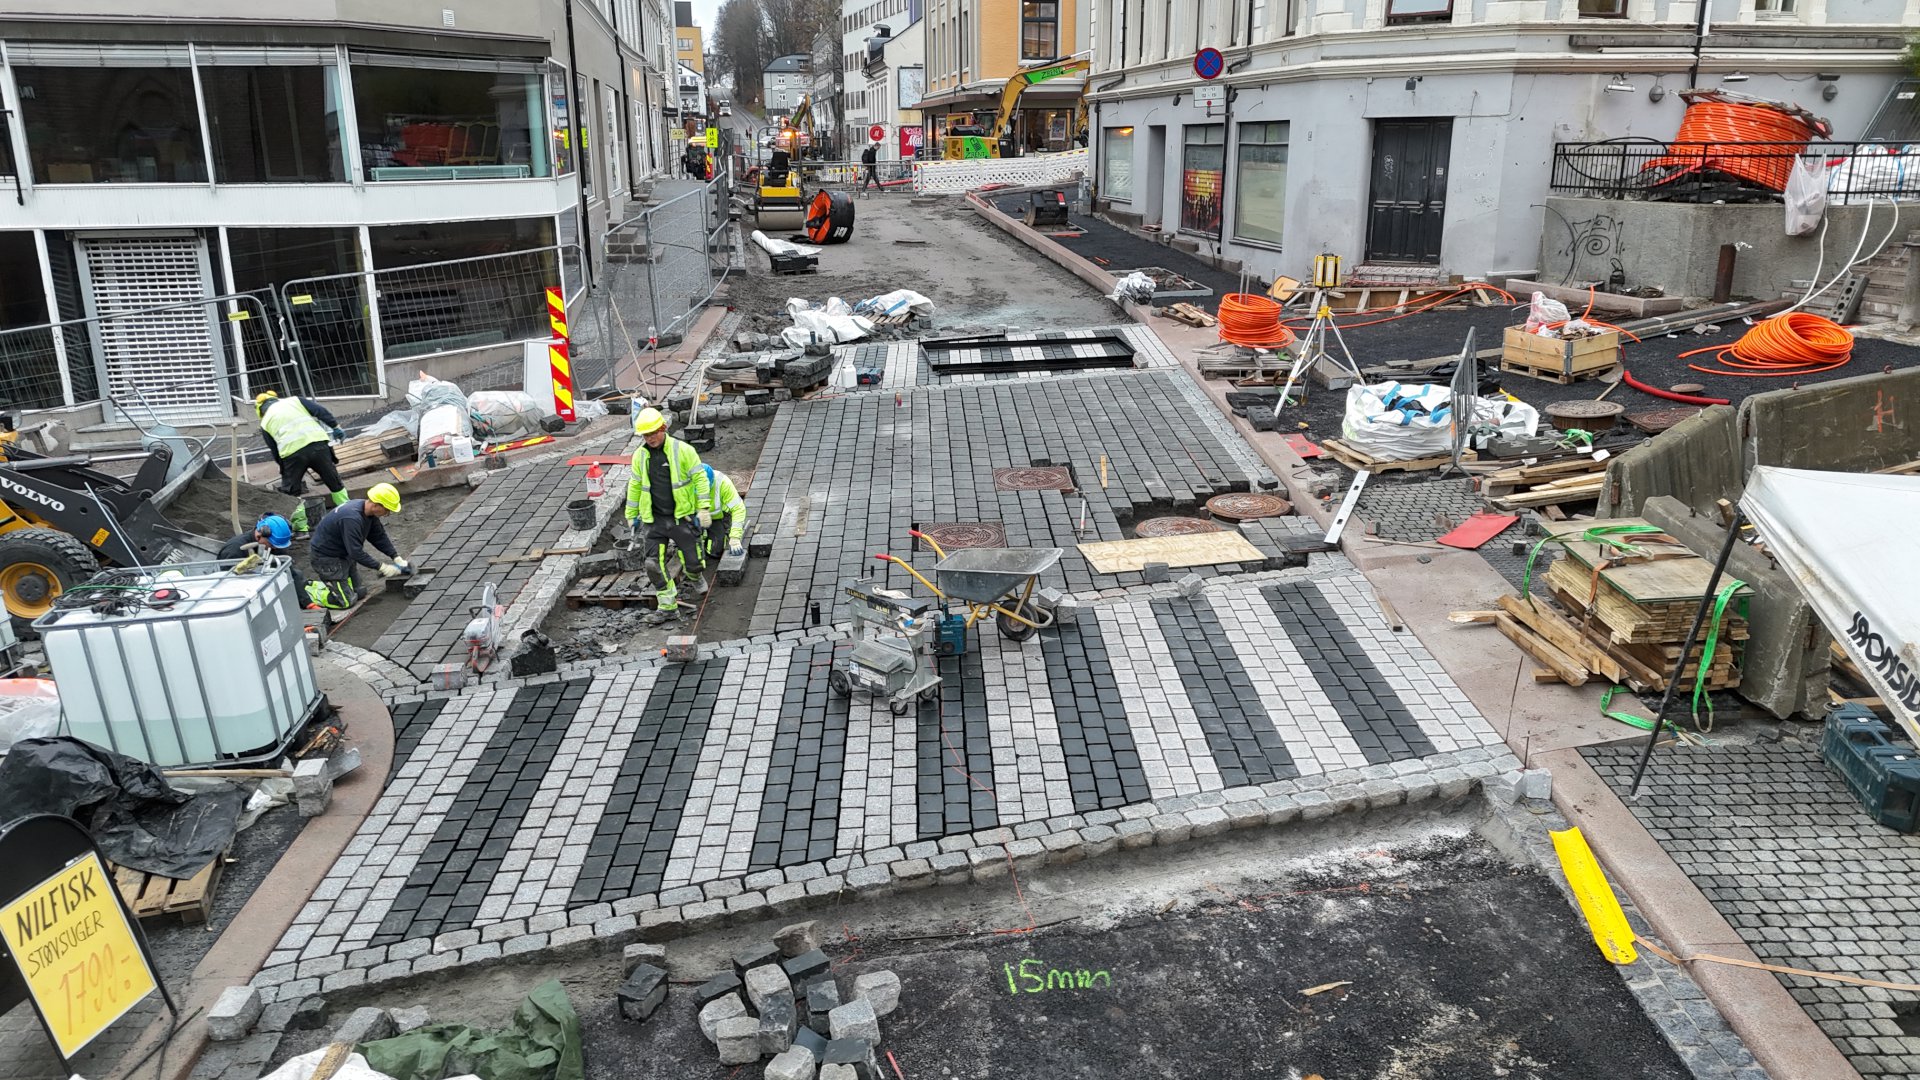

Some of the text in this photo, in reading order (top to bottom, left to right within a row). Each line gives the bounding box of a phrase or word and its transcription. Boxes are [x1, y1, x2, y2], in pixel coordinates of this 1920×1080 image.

[0, 475, 66, 512] VOLVO
[1846, 610, 1920, 725] IRONSID
[16, 866, 97, 948] NILFISK
